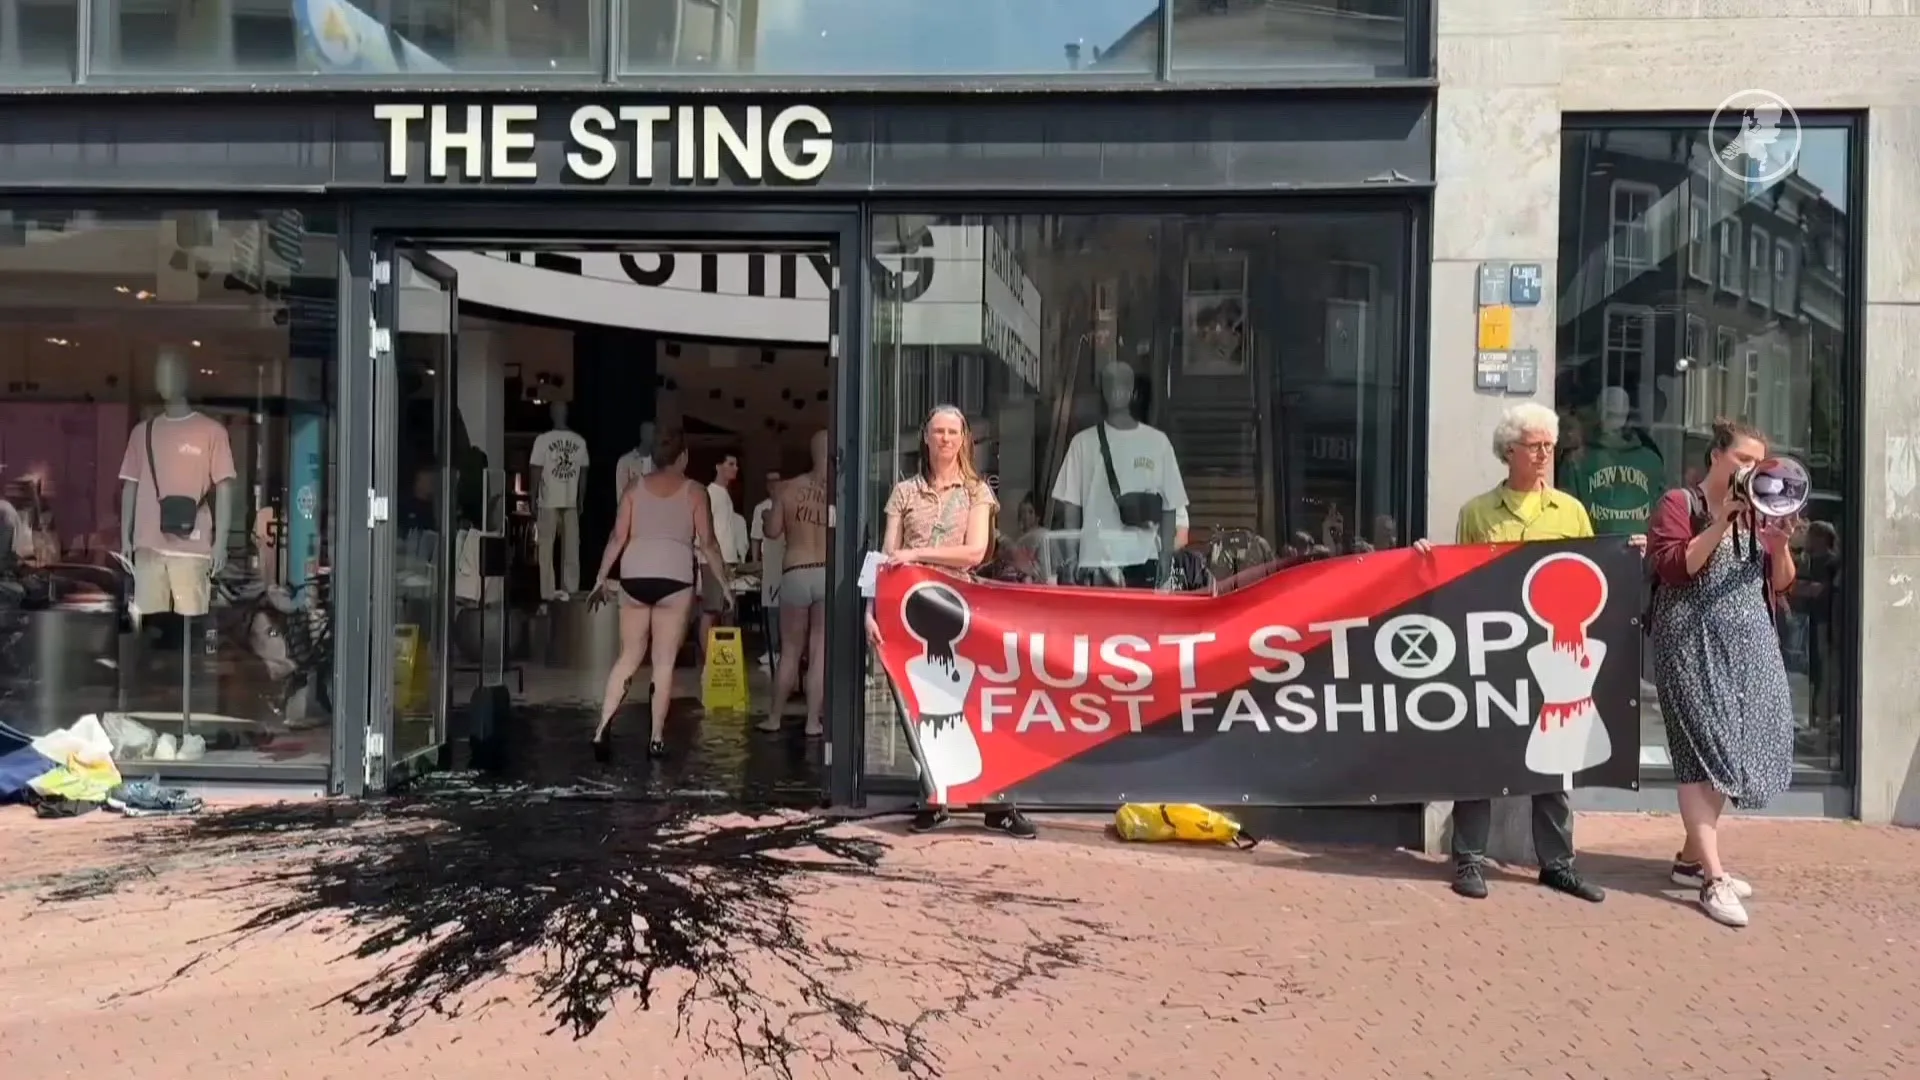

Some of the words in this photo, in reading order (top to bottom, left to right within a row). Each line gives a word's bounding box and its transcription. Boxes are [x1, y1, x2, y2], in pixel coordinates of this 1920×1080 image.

[373, 104, 539, 178] THE
[566, 105, 834, 181] STING
[1588, 465, 1617, 494] NEW
[1617, 465, 1649, 495] YORK
[979, 630, 1217, 692] JUST
[1248, 612, 1530, 684] STOP
[980, 687, 1154, 733] FAST
[1181, 678, 1531, 733] FASHION
